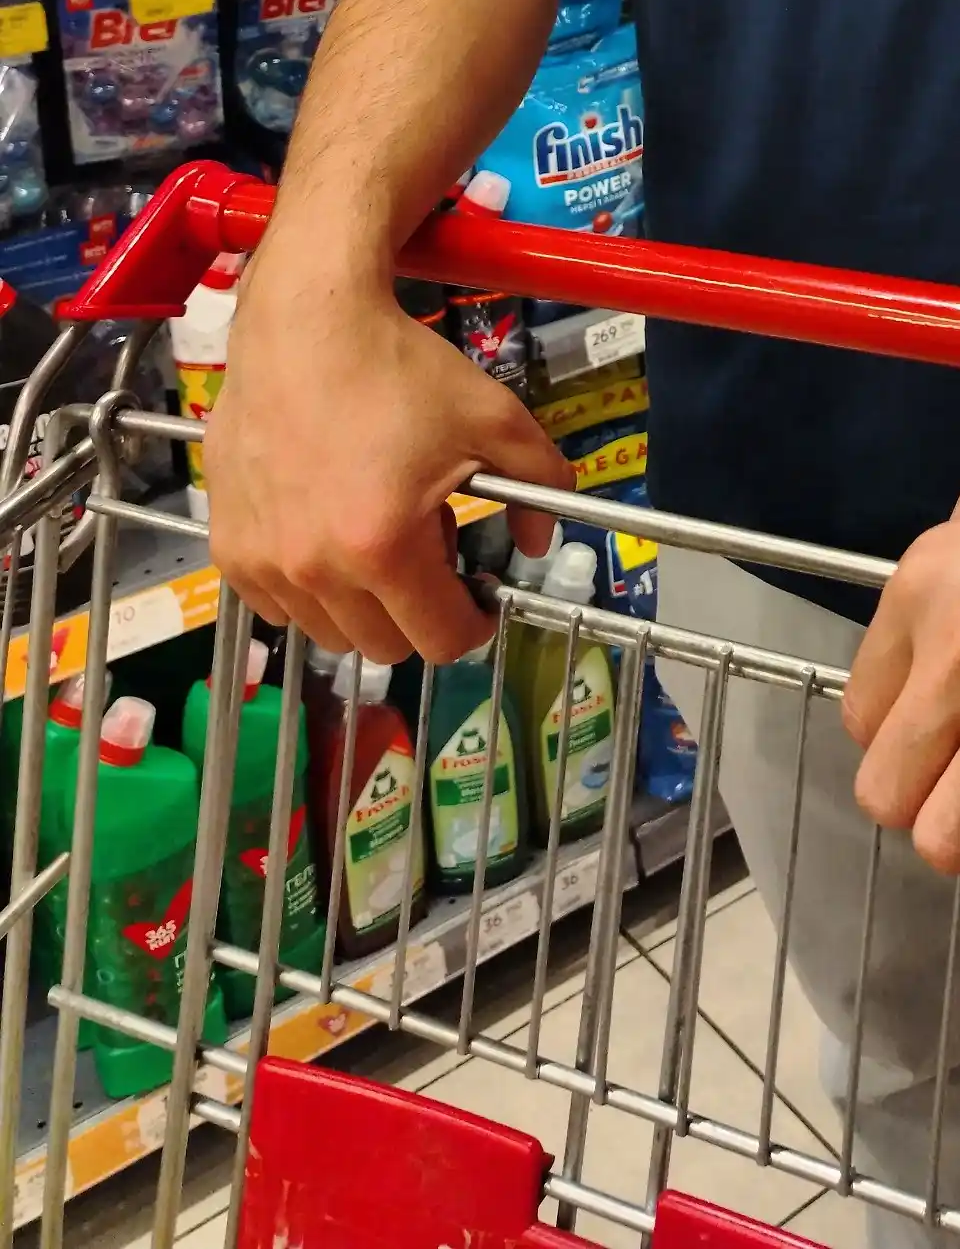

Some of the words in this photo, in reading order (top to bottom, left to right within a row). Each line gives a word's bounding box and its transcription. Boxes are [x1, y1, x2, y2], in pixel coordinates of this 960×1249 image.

[533, 104, 644, 177] finish
[564, 171, 632, 206] POWER
[592, 325, 618, 347] 269
